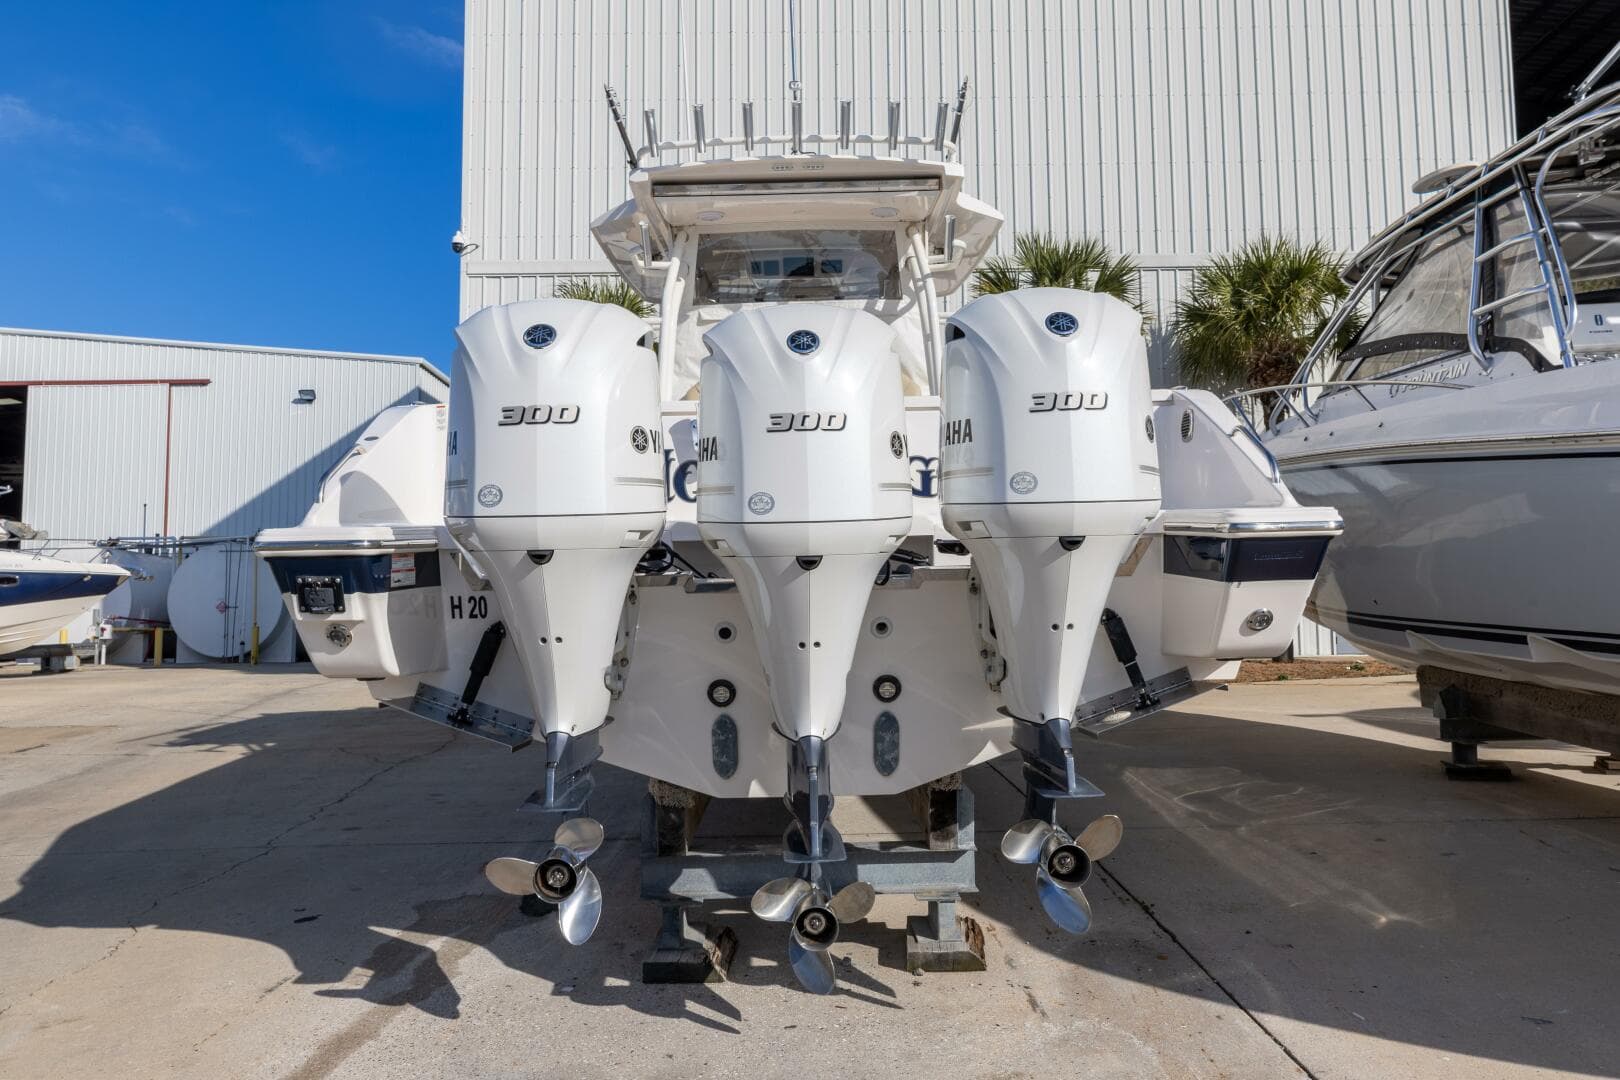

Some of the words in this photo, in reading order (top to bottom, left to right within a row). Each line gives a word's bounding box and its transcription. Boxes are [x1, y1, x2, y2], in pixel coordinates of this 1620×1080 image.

[1029, 391, 1108, 413] 300
[498, 404, 580, 426] 300
[766, 411, 847, 433] 300
[450, 595, 463, 619] H
[468, 595, 488, 619] 20
